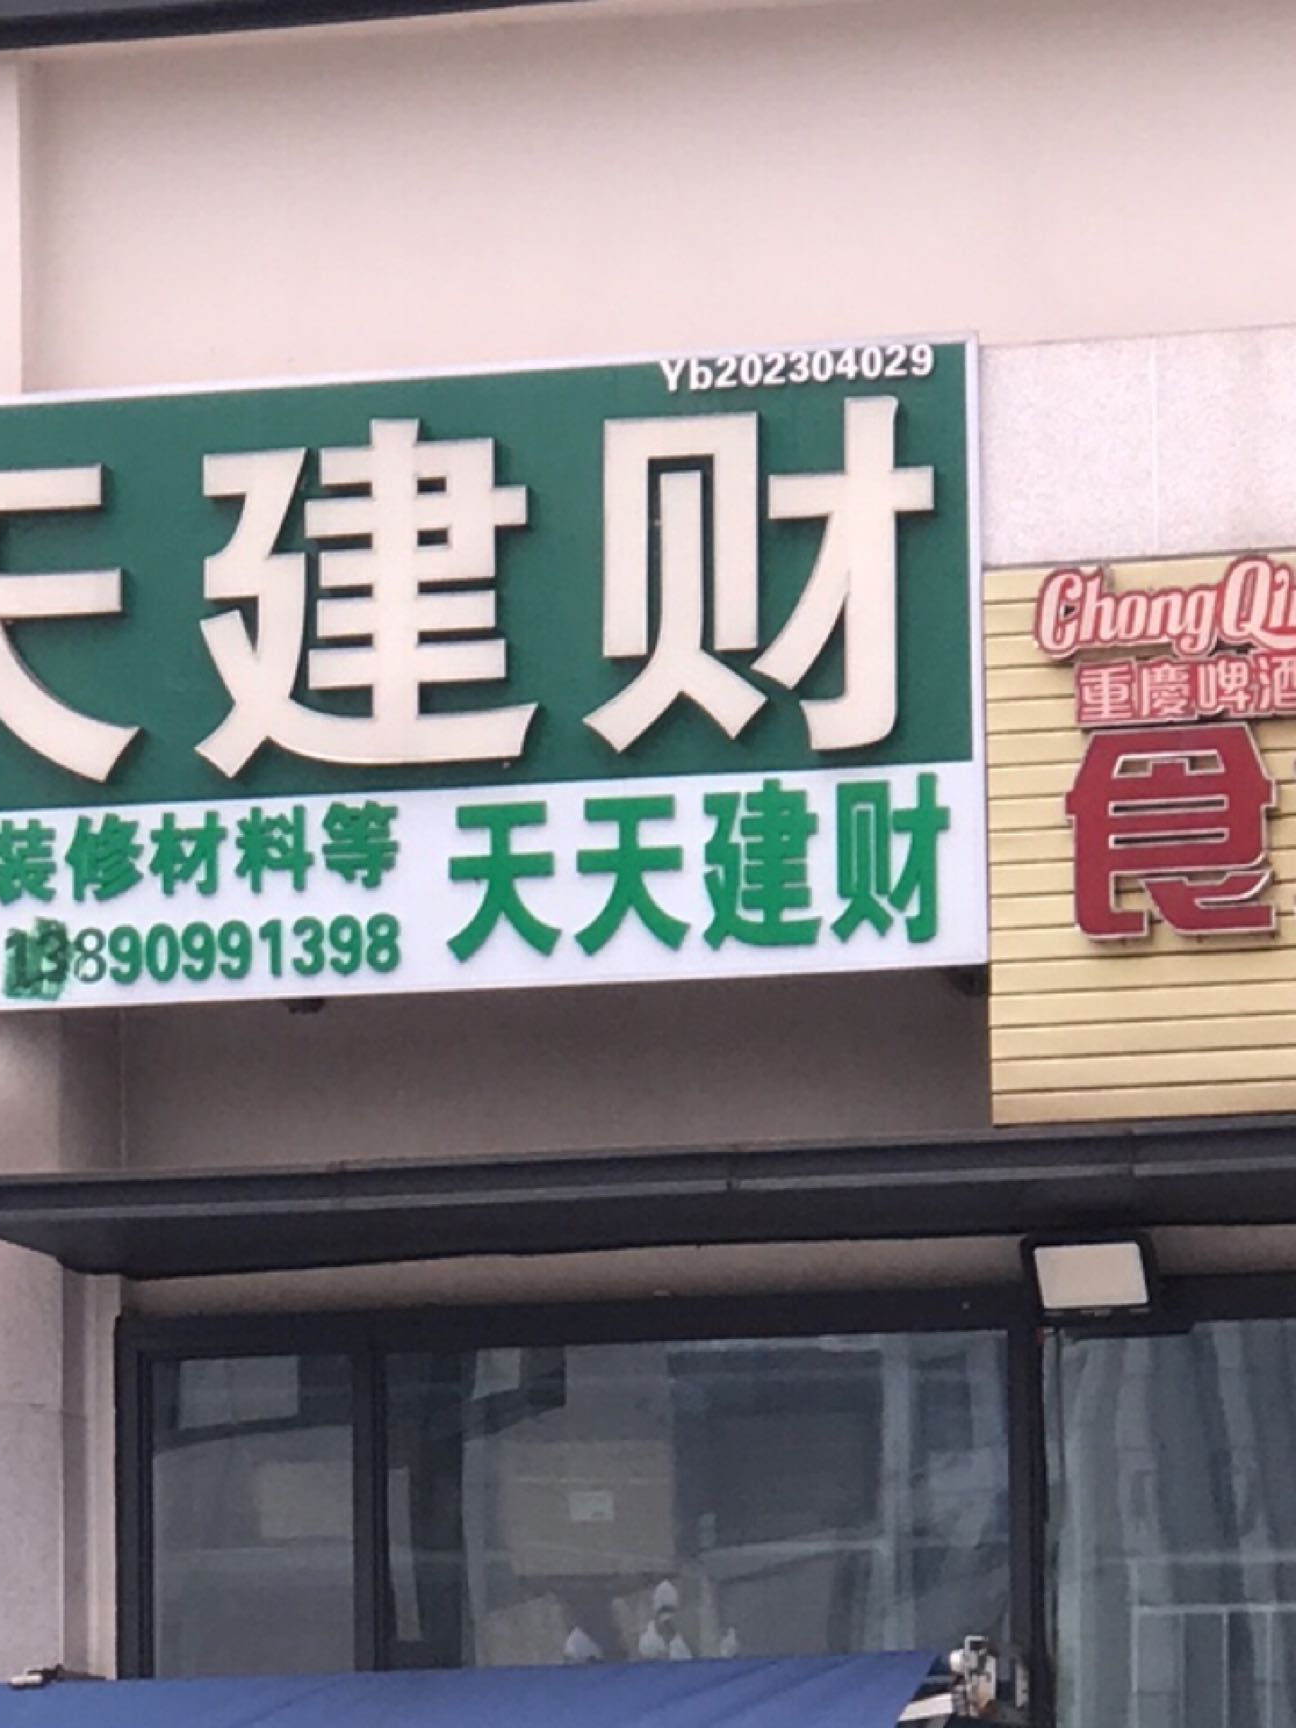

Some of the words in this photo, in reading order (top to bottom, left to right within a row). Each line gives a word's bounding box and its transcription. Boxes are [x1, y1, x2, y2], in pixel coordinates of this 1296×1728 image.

[660, 343, 934, 392] Yb202304029
[1035, 554, 1296, 658] ChongQi
[446, 772, 950, 963] 天天建财
[3, 913, 401, 997] 13890991398
